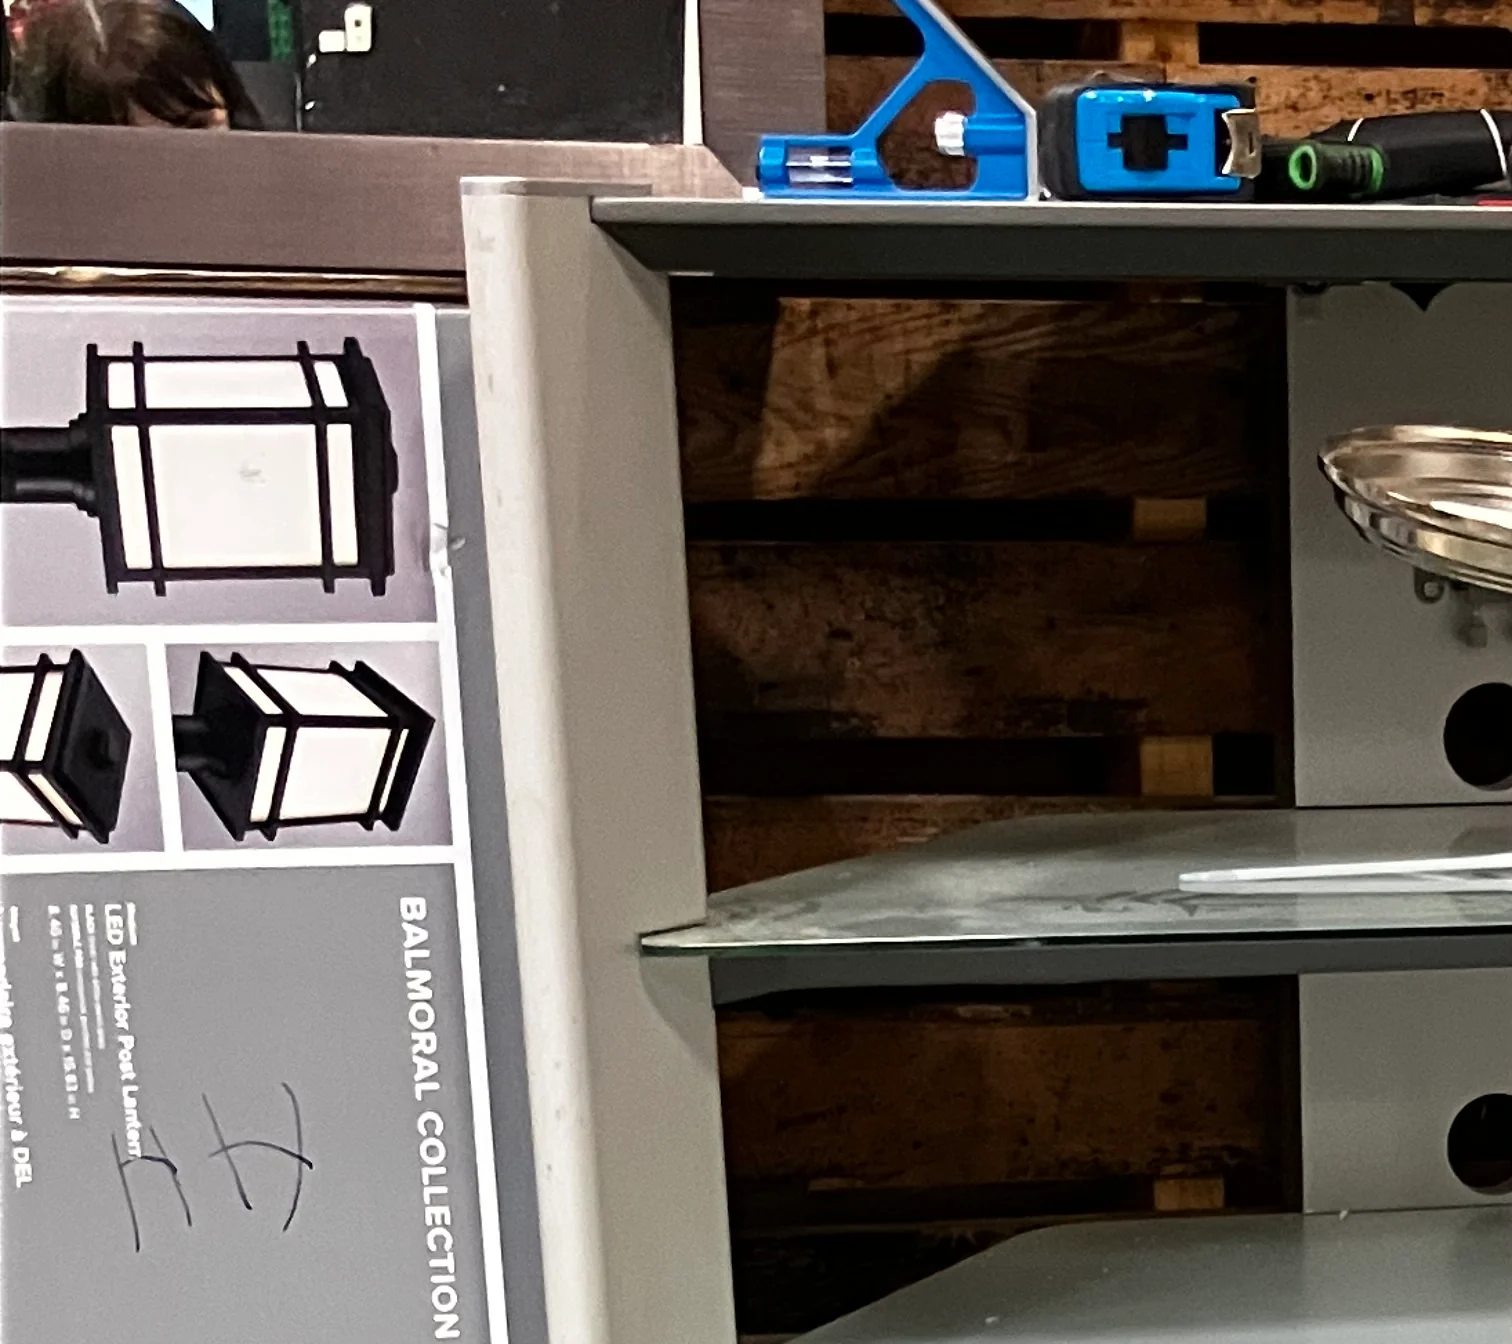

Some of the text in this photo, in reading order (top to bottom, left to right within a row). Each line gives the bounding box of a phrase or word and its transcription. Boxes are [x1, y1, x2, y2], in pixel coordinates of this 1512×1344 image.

[104, 903, 124, 945] LED
[108, 949, 131, 1031] Exterior
[117, 1034, 136, 1081] Post
[10, 1129, 28, 1142] à
[400, 896, 460, 1339] BALMORAL COLLECTION
[12, 1146, 33, 1188] DEL
